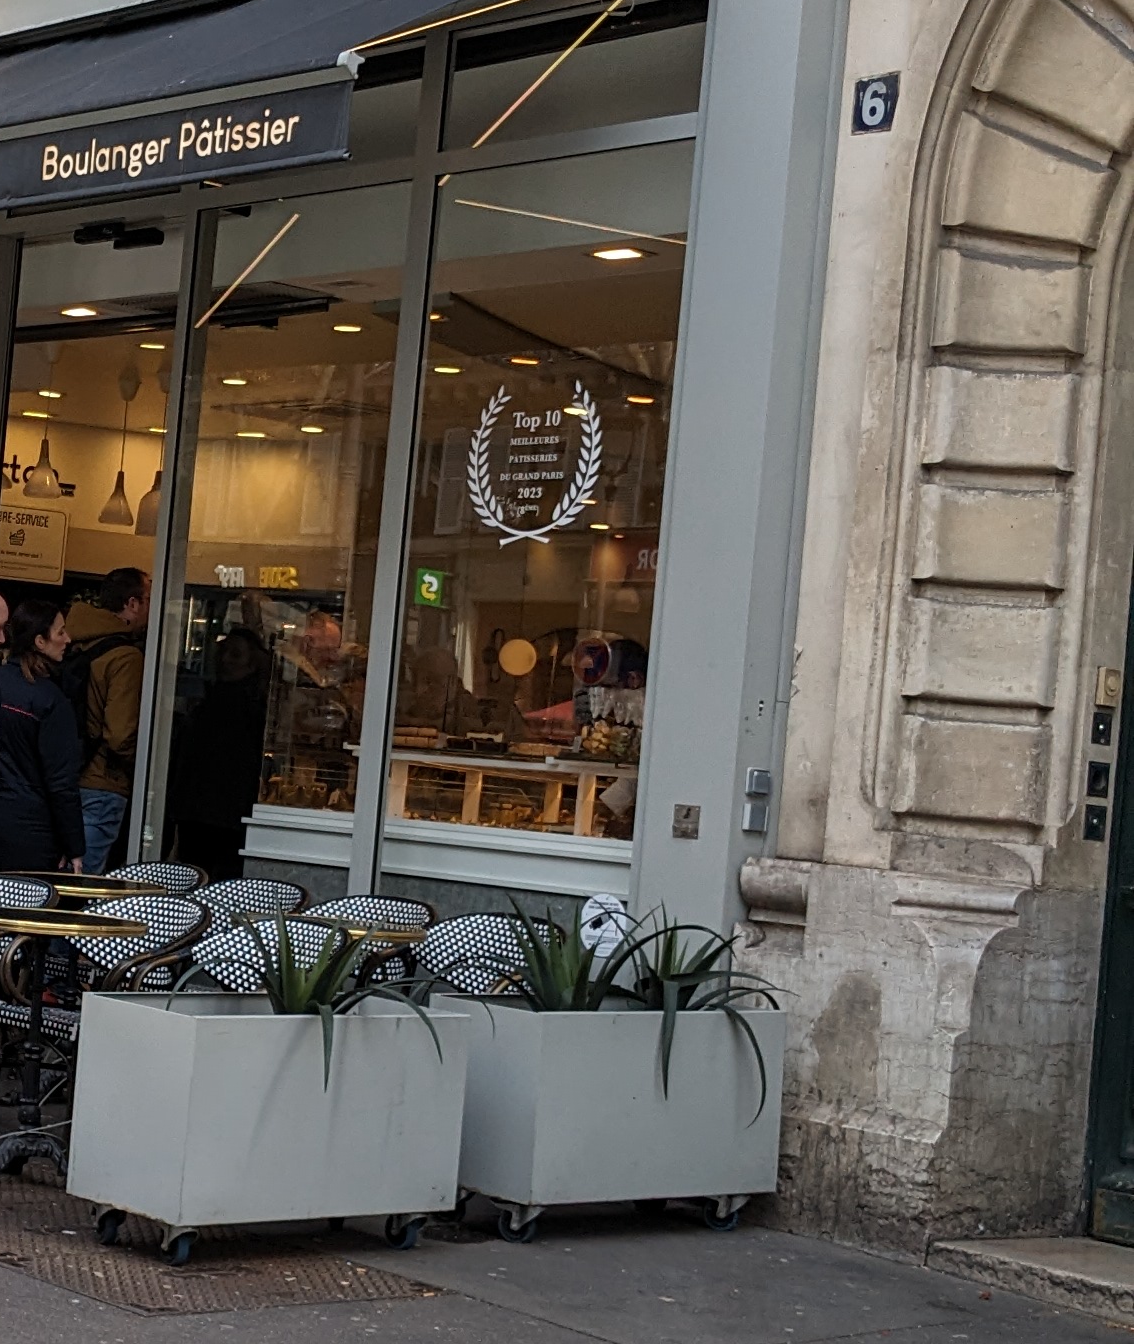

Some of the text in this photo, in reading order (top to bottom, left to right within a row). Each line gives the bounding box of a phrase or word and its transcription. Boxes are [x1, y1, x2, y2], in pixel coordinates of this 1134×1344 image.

[861, 81, 887, 126] 6
[42, 108, 300, 181] Boulanger Pâtissier
[512, 409, 561, 432] Top 10
[509, 435, 560, 446] MEILLEURES
[499, 471, 564, 481] DU GRAND PARIS
[517, 487, 543, 499] 2023
